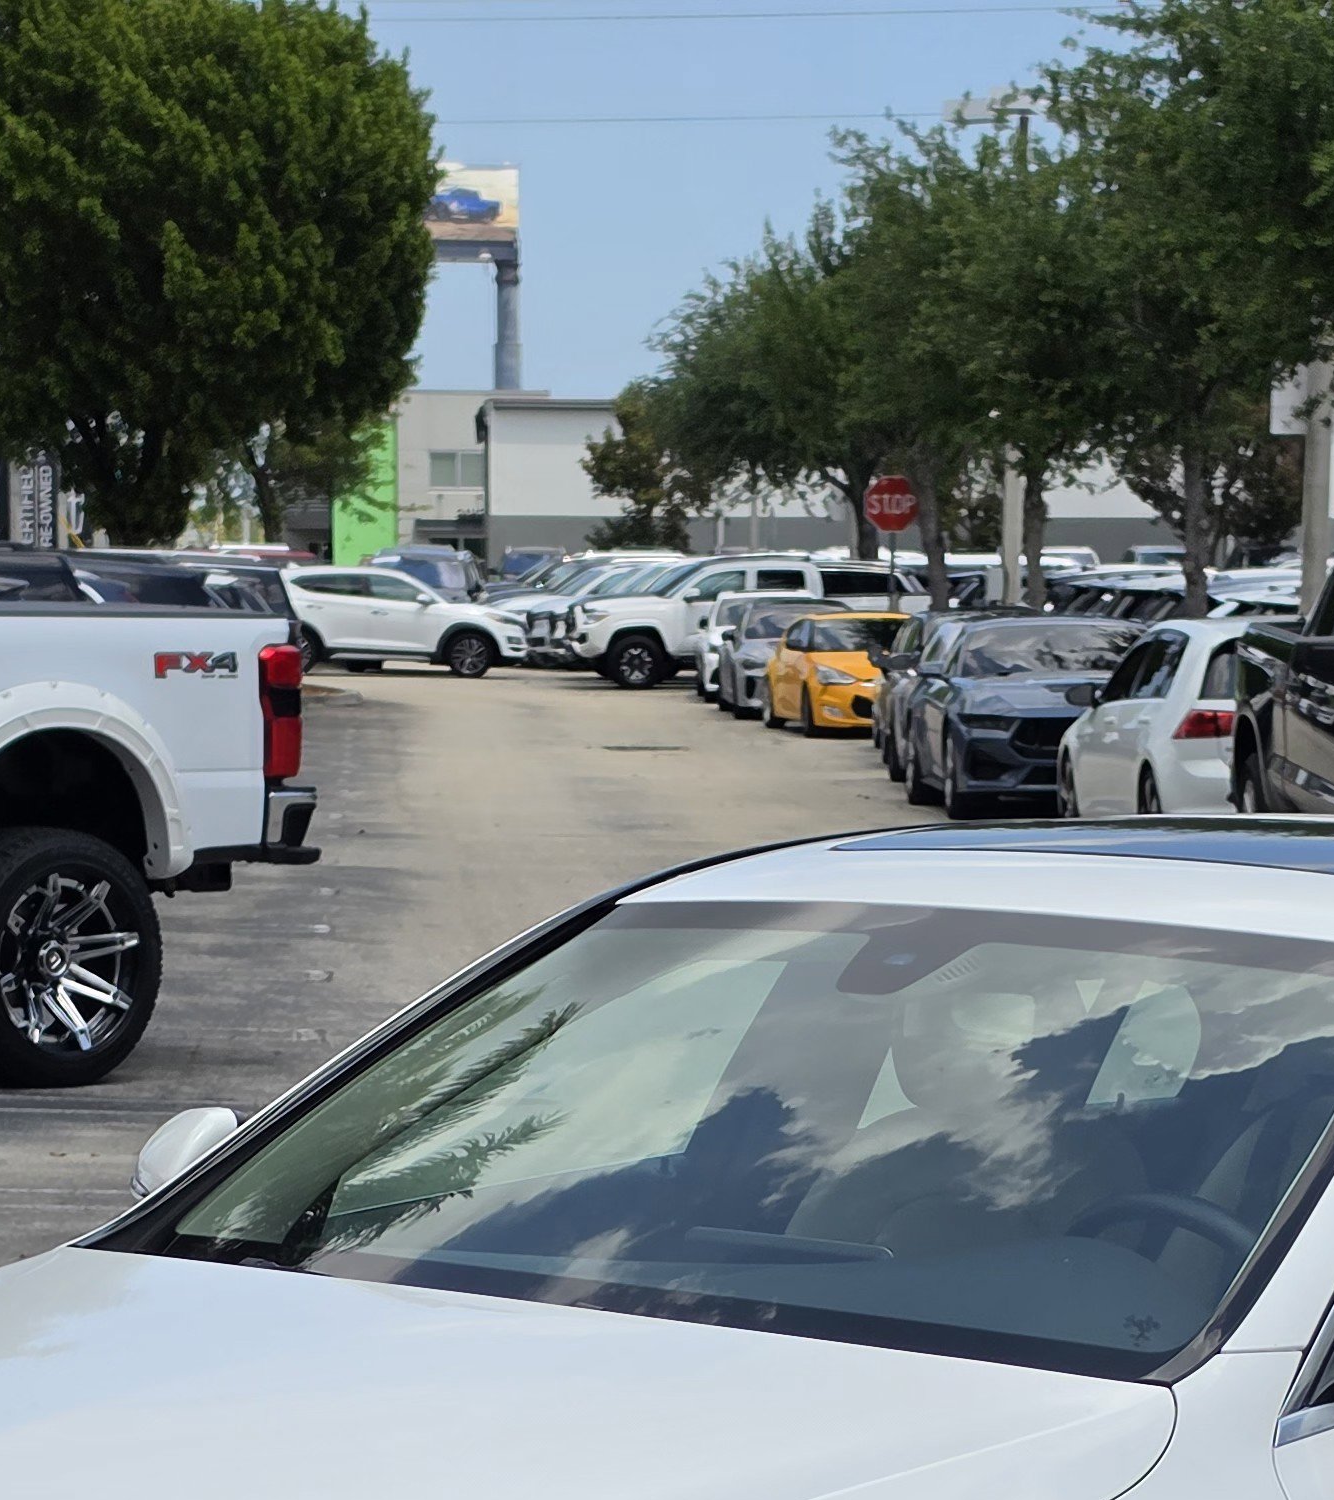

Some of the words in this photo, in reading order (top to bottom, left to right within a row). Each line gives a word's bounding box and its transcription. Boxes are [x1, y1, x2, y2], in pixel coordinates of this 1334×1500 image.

[39, 465, 53, 548] RE-OWNED
[867, 493, 917, 515] STOP
[154, 651, 238, 679] FX4
